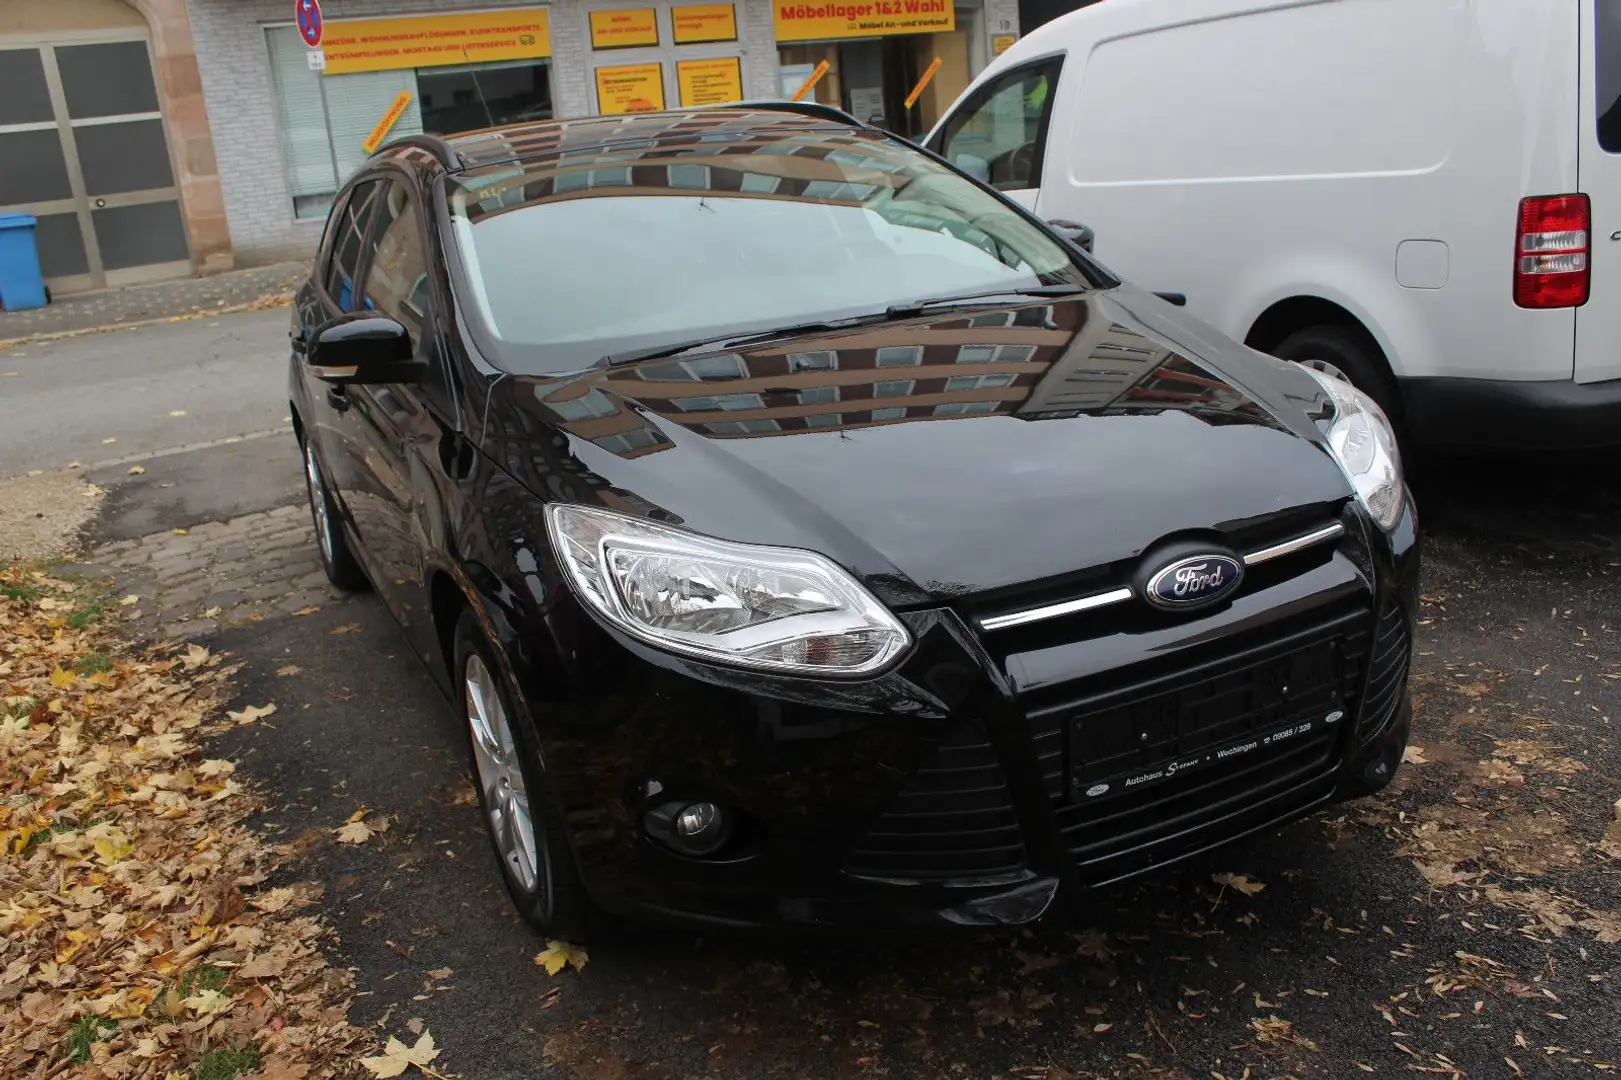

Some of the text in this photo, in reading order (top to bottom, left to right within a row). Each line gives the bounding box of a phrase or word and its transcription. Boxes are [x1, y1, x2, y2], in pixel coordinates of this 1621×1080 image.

[781, 0, 945, 20] Möbellager 1&2 Wahl
[859, 20, 884, 29] Möbel
[918, 17, 948, 26] Verkauf
[1174, 563, 1224, 597] Ford
[1125, 770, 1163, 787] Autohaus
[1272, 728, 1293, 741] 09085
[1299, 722, 1311, 733] 329
